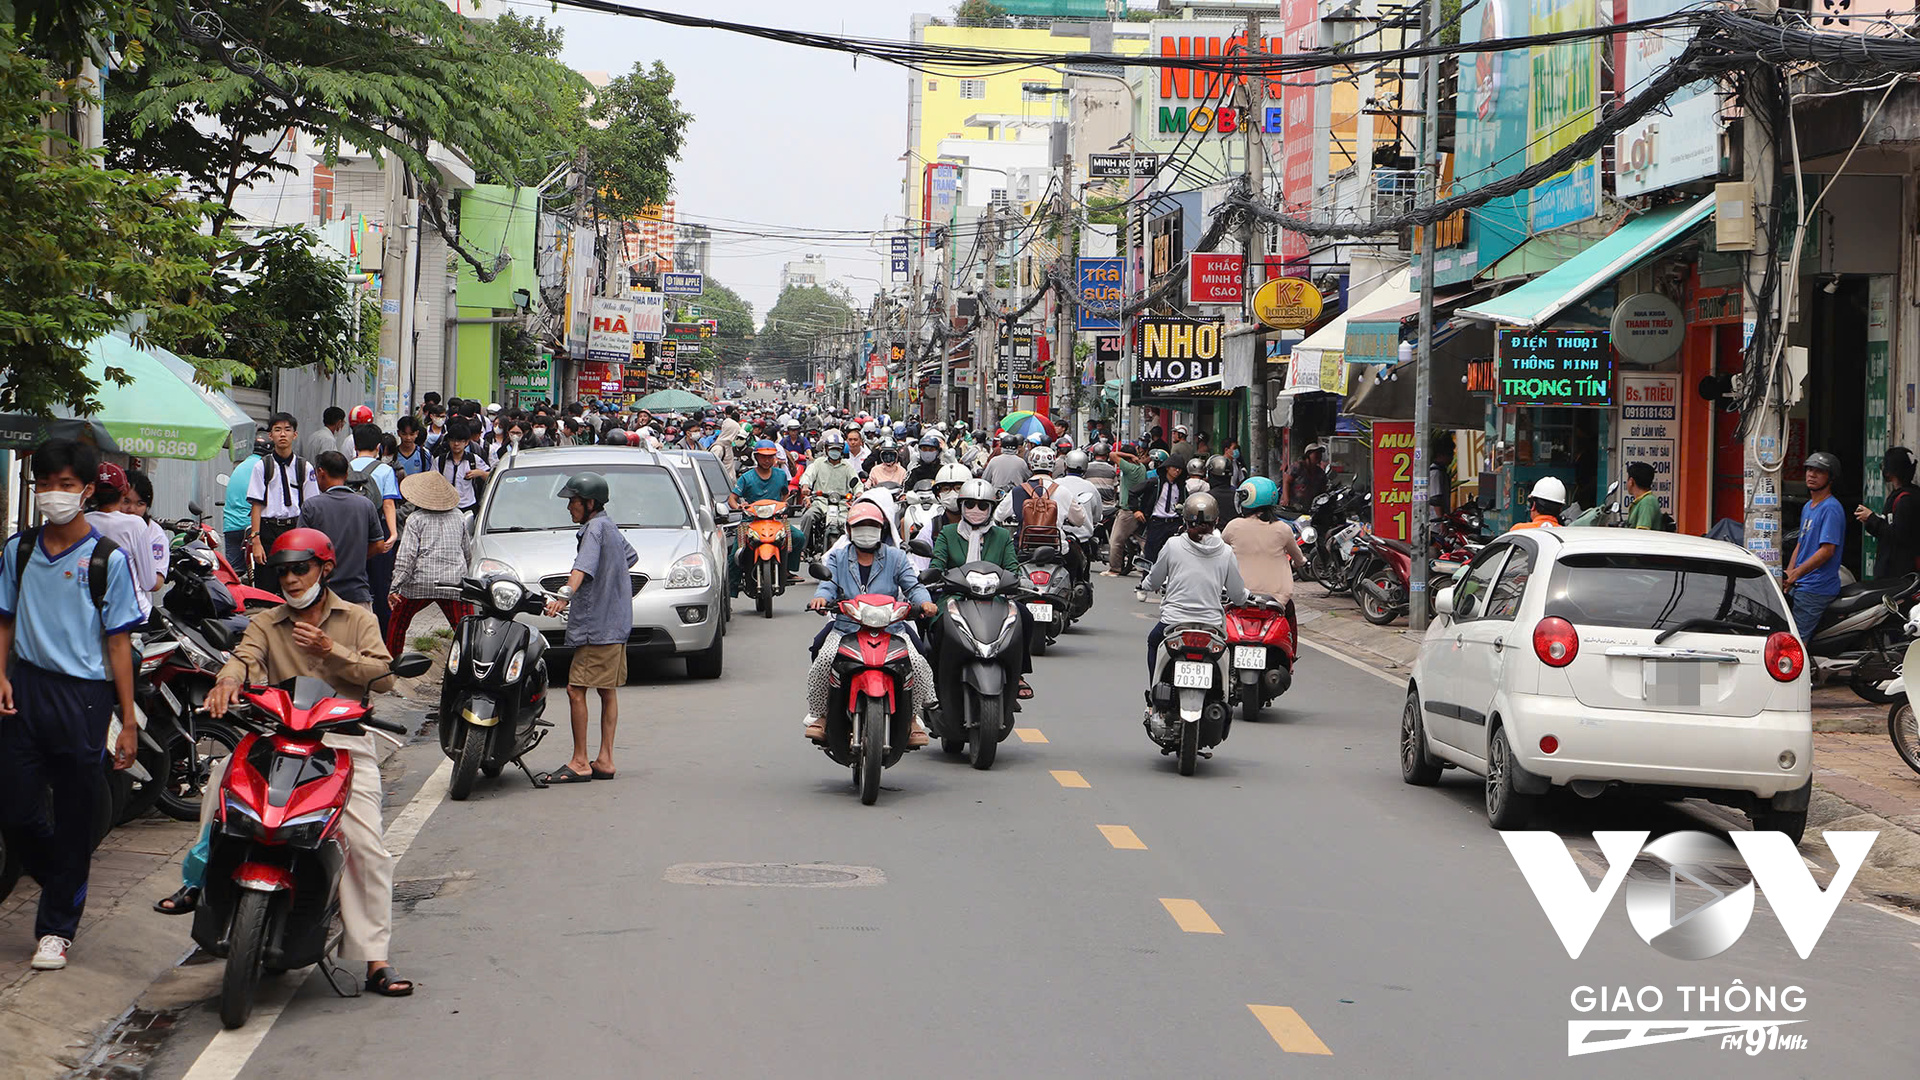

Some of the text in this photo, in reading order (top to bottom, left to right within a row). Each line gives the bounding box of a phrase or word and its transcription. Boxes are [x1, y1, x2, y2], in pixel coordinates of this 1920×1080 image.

[1094, 158, 1117, 168] MINH
[1123, 168, 1145, 176] STRE
[1207, 260, 1240, 271] KHẮC
[1202, 274, 1231, 283] MINH
[1210, 286, 1237, 297] (SAO
[1276, 282, 1305, 306] K2
[646, 296, 661, 306] MAY
[1265, 306, 1313, 320] homestay
[593, 314, 629, 333] HÀ
[1624, 320, 1649, 329] THANH
[1511, 336, 1598, 352] ĐIỆN THOẠI
[1512, 354, 1599, 370] THÔNG MINH
[998, 373, 1019, 382] MOEL
[1502, 374, 1607, 399] TRỌNG TÍN
[1626, 387, 1641, 401] Bs.
[1625, 407, 1673, 419] 0918181438
[1642, 425, 1653, 436] LÀM
[1655, 425, 1666, 438] VIỆC
[117, 437, 198, 456] 1800 6869
[1393, 453, 1410, 482] 2
[1380, 488, 1412, 506] TẶN
[1393, 511, 1406, 540] 1
[1236, 658, 1264, 667] 546.40
[1181, 665, 1205, 674] 65-B1
[1177, 675, 1209, 686] 703.70
